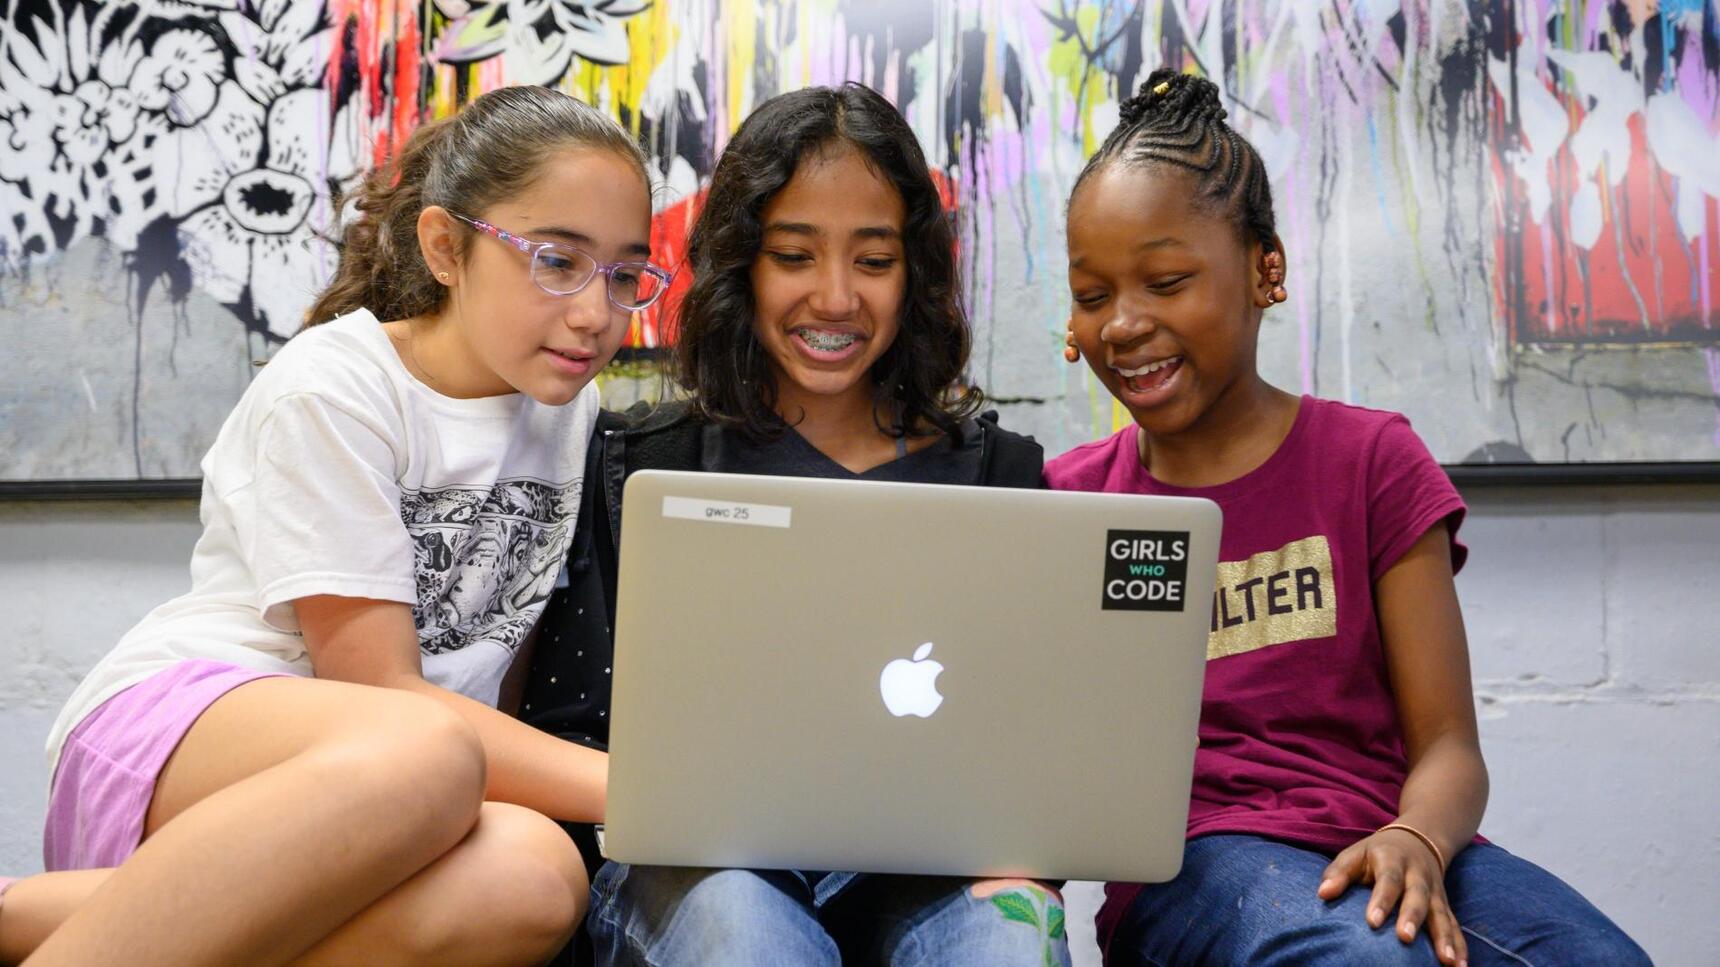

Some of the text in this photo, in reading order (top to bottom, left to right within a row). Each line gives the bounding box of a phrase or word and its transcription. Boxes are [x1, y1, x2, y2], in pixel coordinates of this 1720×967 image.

[706, 507, 749, 520] gwc 25
[1110, 539, 1185, 561] GIRLS
[1129, 564, 1165, 576] WHO
[1107, 579, 1181, 601] CODE
